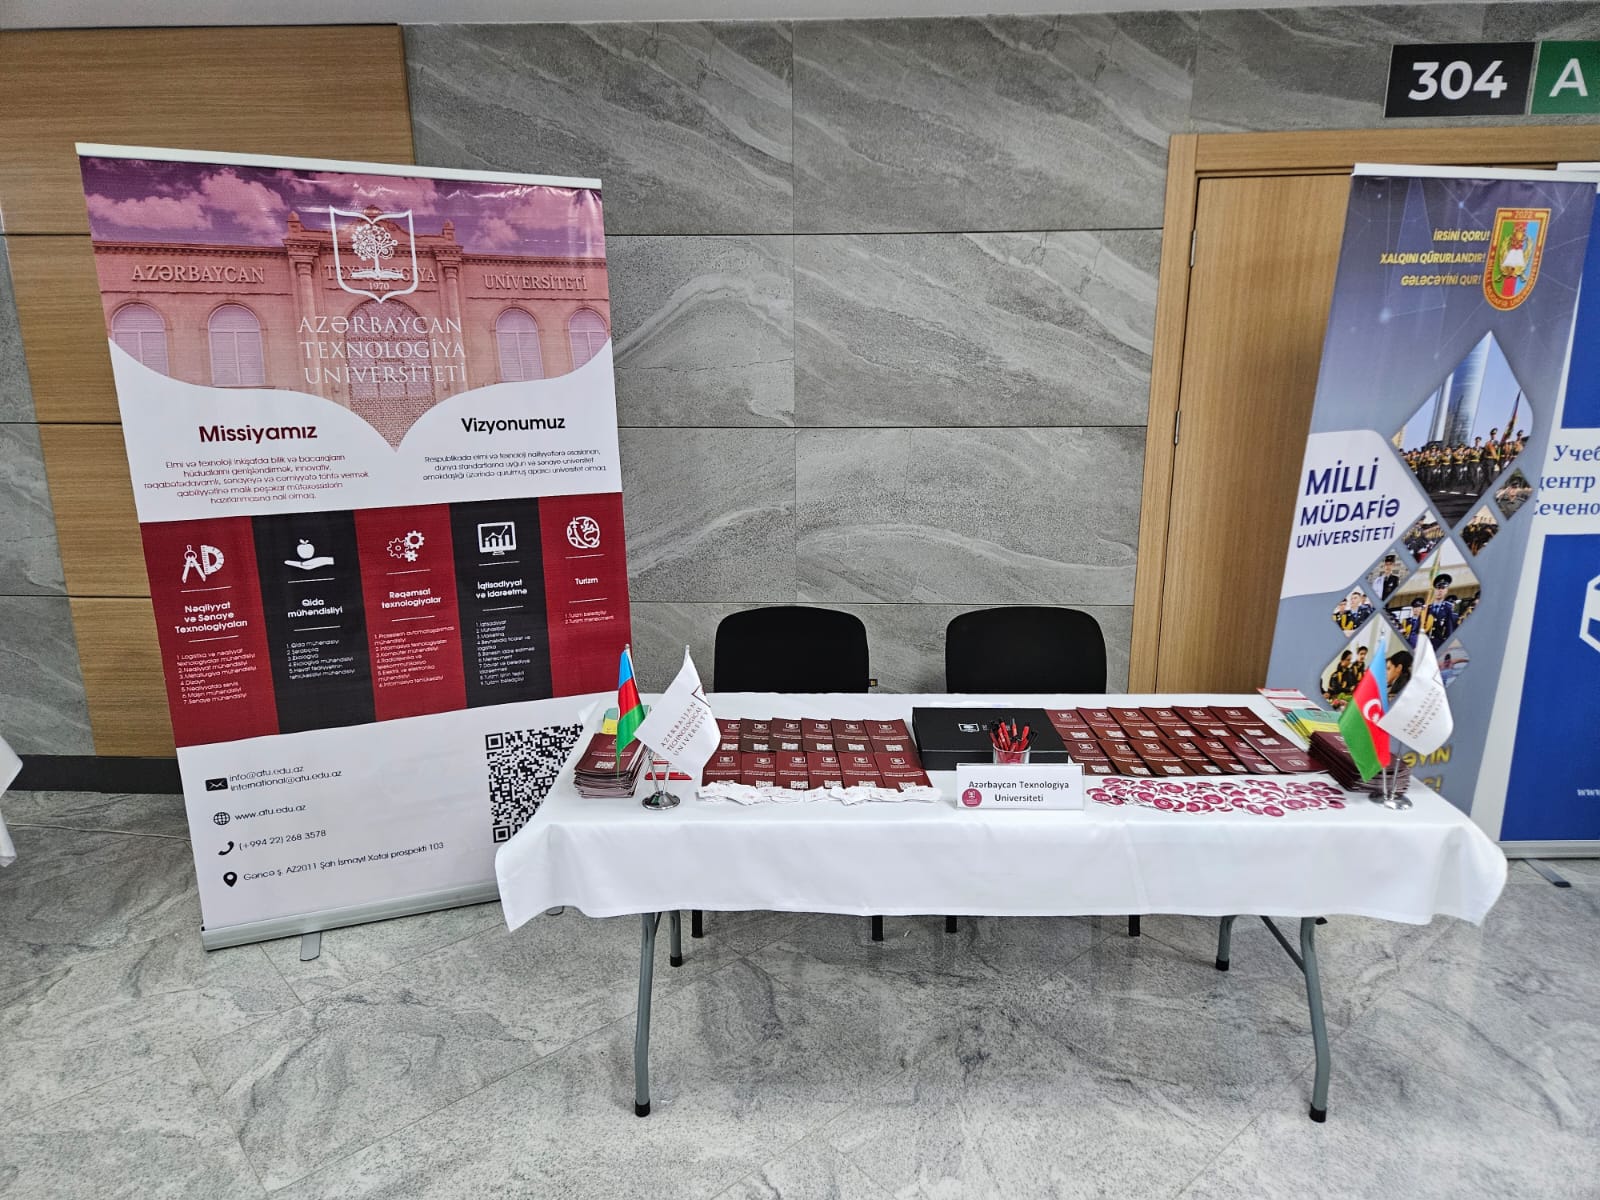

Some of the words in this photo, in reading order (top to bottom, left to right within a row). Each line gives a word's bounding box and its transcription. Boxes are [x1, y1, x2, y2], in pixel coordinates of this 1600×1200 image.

[1408, 60, 1508, 100] 304
[1548, 58, 1588, 97] A
[1461, 229, 1490, 242] QORU!
[1380, 253, 1419, 265] XALQINI
[131, 264, 265, 284] AZƏRBAYCAN
[483, 273, 588, 292] UNİVERSİTETİ
[1460, 275, 1481, 286] QUR!
[368, 282, 390, 291] 1970
[298, 316, 462, 334] AZƏRBAYCAN
[300, 338, 466, 359] TEXNOLOGİYA
[304, 362, 466, 385] UNİVERSİTETİ
[198, 423, 318, 443] Missiyamız
[460, 416, 565, 434] Vizyonumuz
[1305, 457, 1378, 496] MİLLİ
[1300, 494, 1400, 526] MÜDAFİƏ
[1296, 522, 1396, 548] UNİVERSİTETİ
[184, 601, 231, 613] Nəqliyyat
[302, 598, 325, 606] Qida
[229, 765, 304, 782] info@atu.edu.az
[968, 780, 1016, 790] Azərbaycan
[1019, 780, 1069, 790] Texnologiya
[994, 794, 1043, 802] Universiteti
[234, 804, 306, 820] www.atu.edu.az
[269, 836, 284, 846] 22)
[286, 833, 302, 842] 268
[305, 829, 327, 840] 3578
[286, 863, 317, 874] AZ2011
[429, 842, 444, 851] 103
